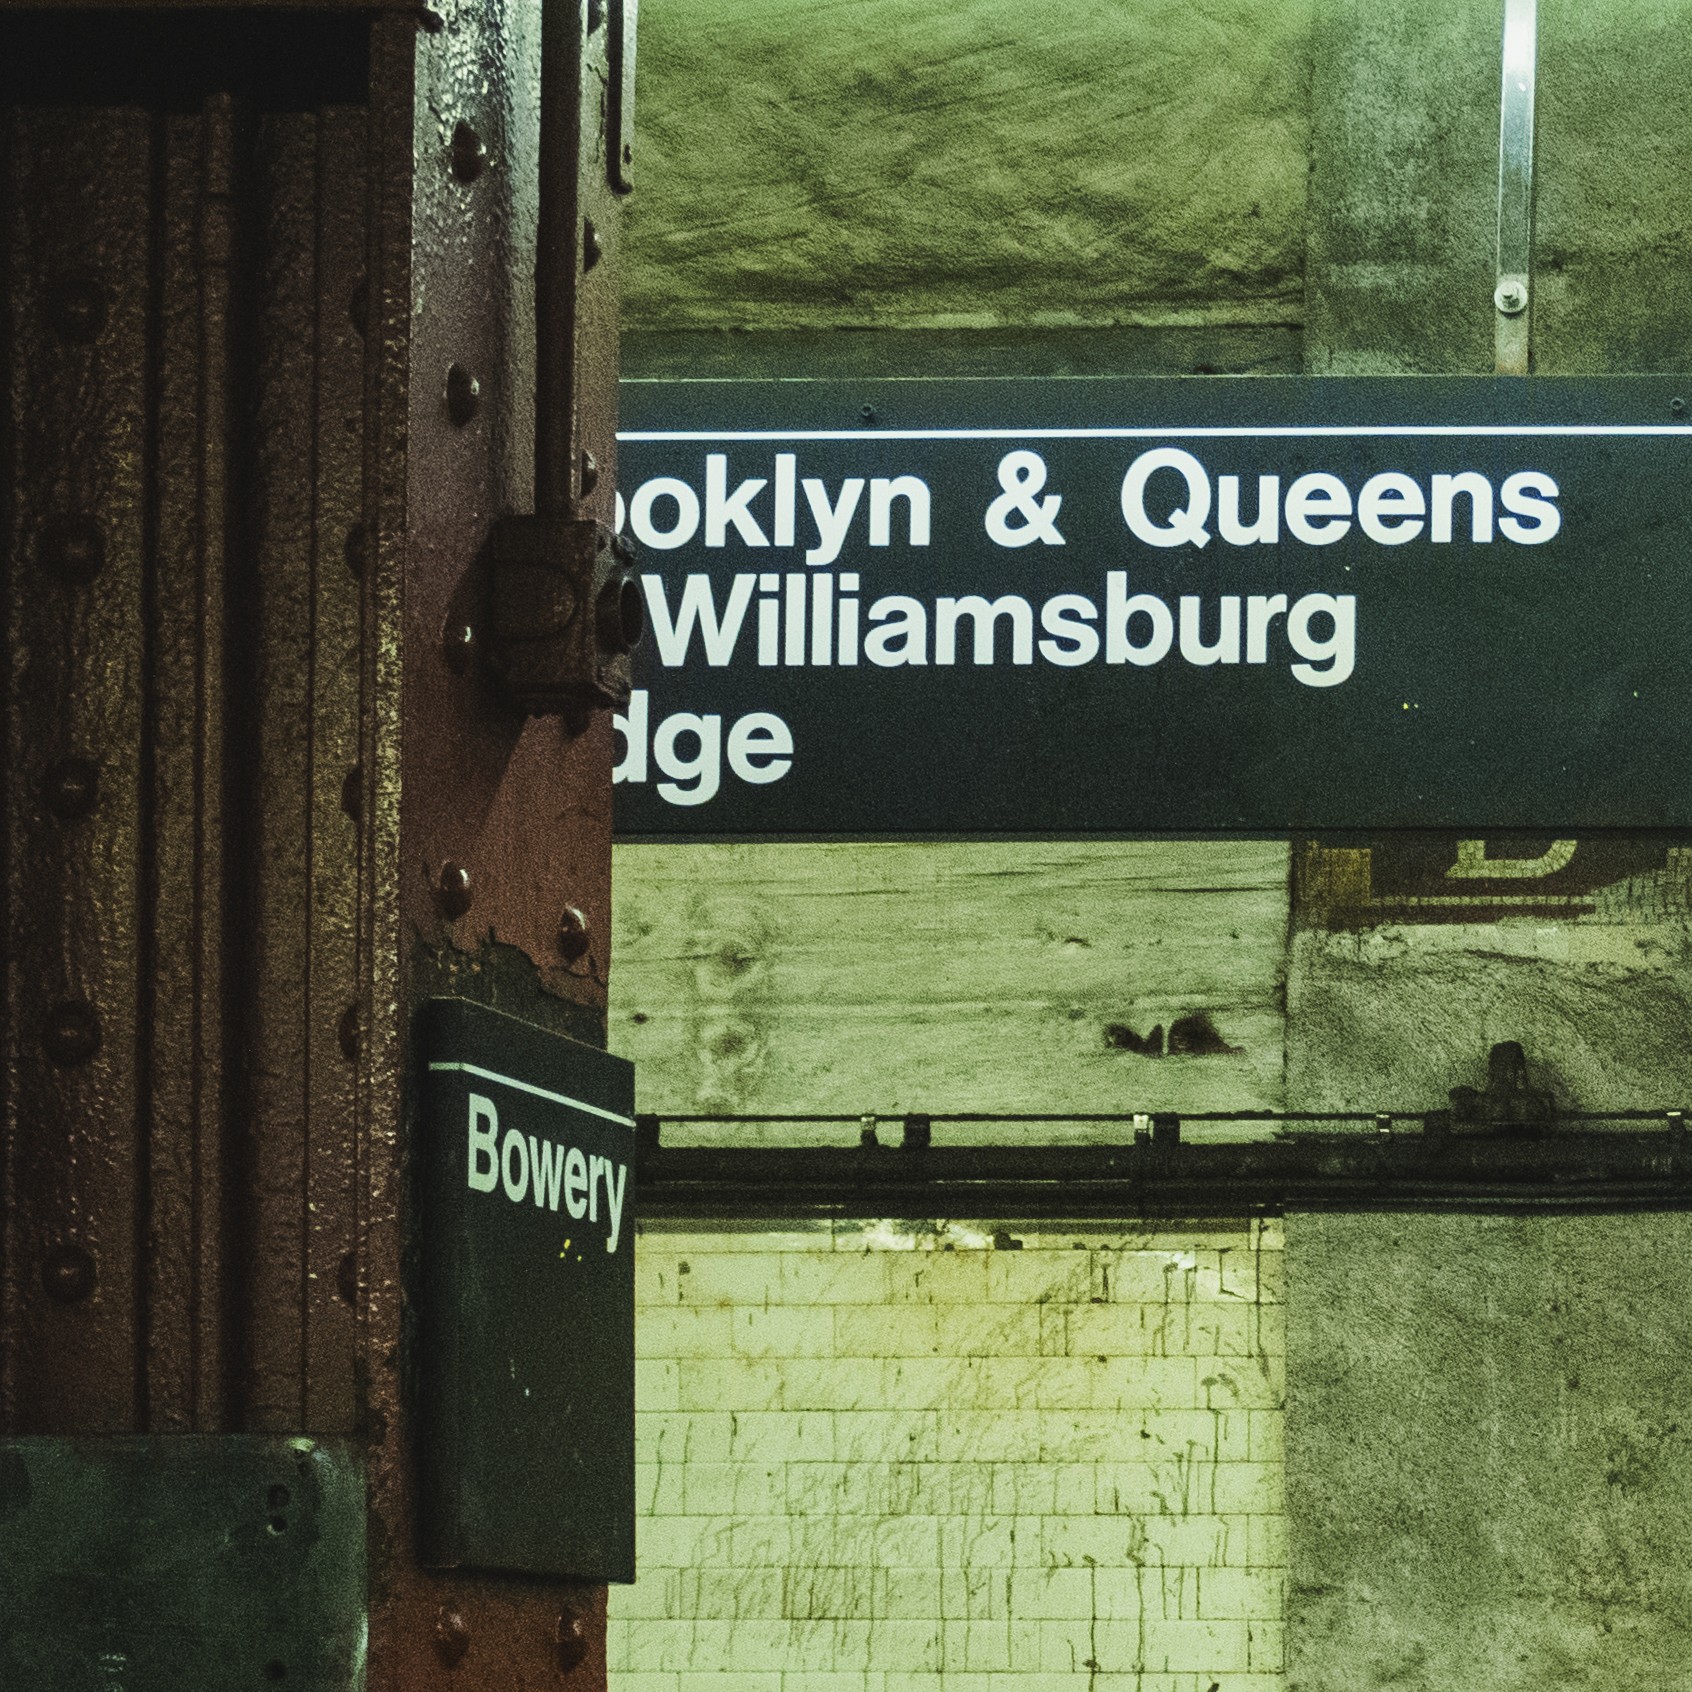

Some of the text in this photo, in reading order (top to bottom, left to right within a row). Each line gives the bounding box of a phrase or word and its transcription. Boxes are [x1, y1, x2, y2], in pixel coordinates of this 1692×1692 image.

[613, 447, 1561, 566] oklyn & Queens
[640, 570, 1357, 688] Williamsburg
[467, 1092, 627, 1254] Bowery
